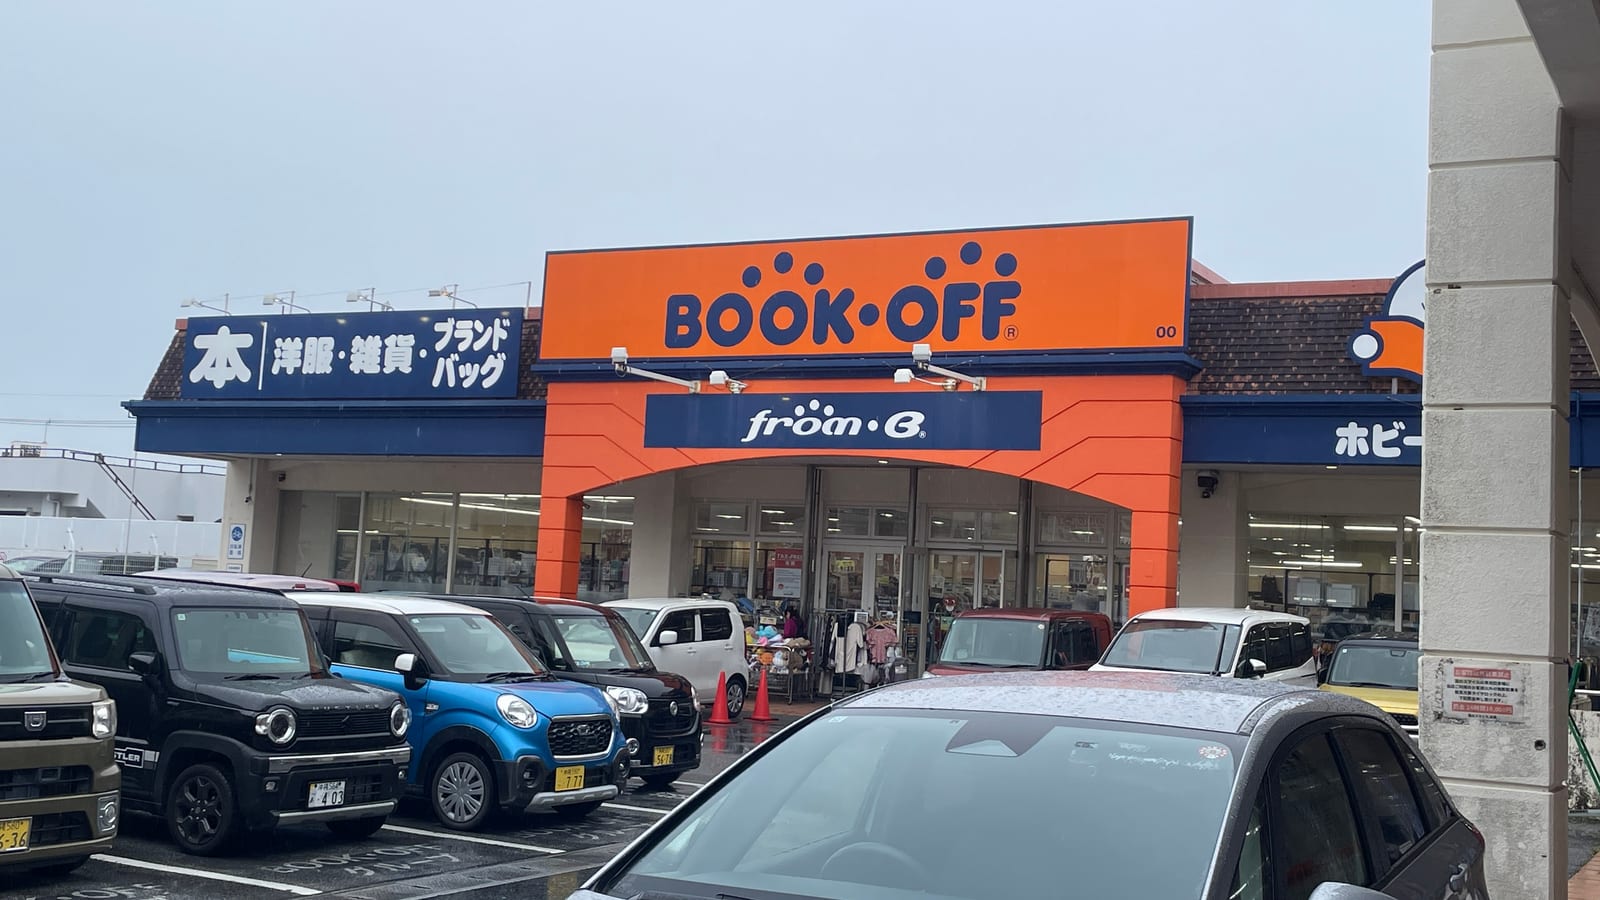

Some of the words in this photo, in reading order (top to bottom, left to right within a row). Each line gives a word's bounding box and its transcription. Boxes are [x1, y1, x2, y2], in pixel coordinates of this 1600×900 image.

[434, 317, 511, 352] ブランド
[189, 325, 254, 389] 本
[432, 353, 507, 389] バッグ
